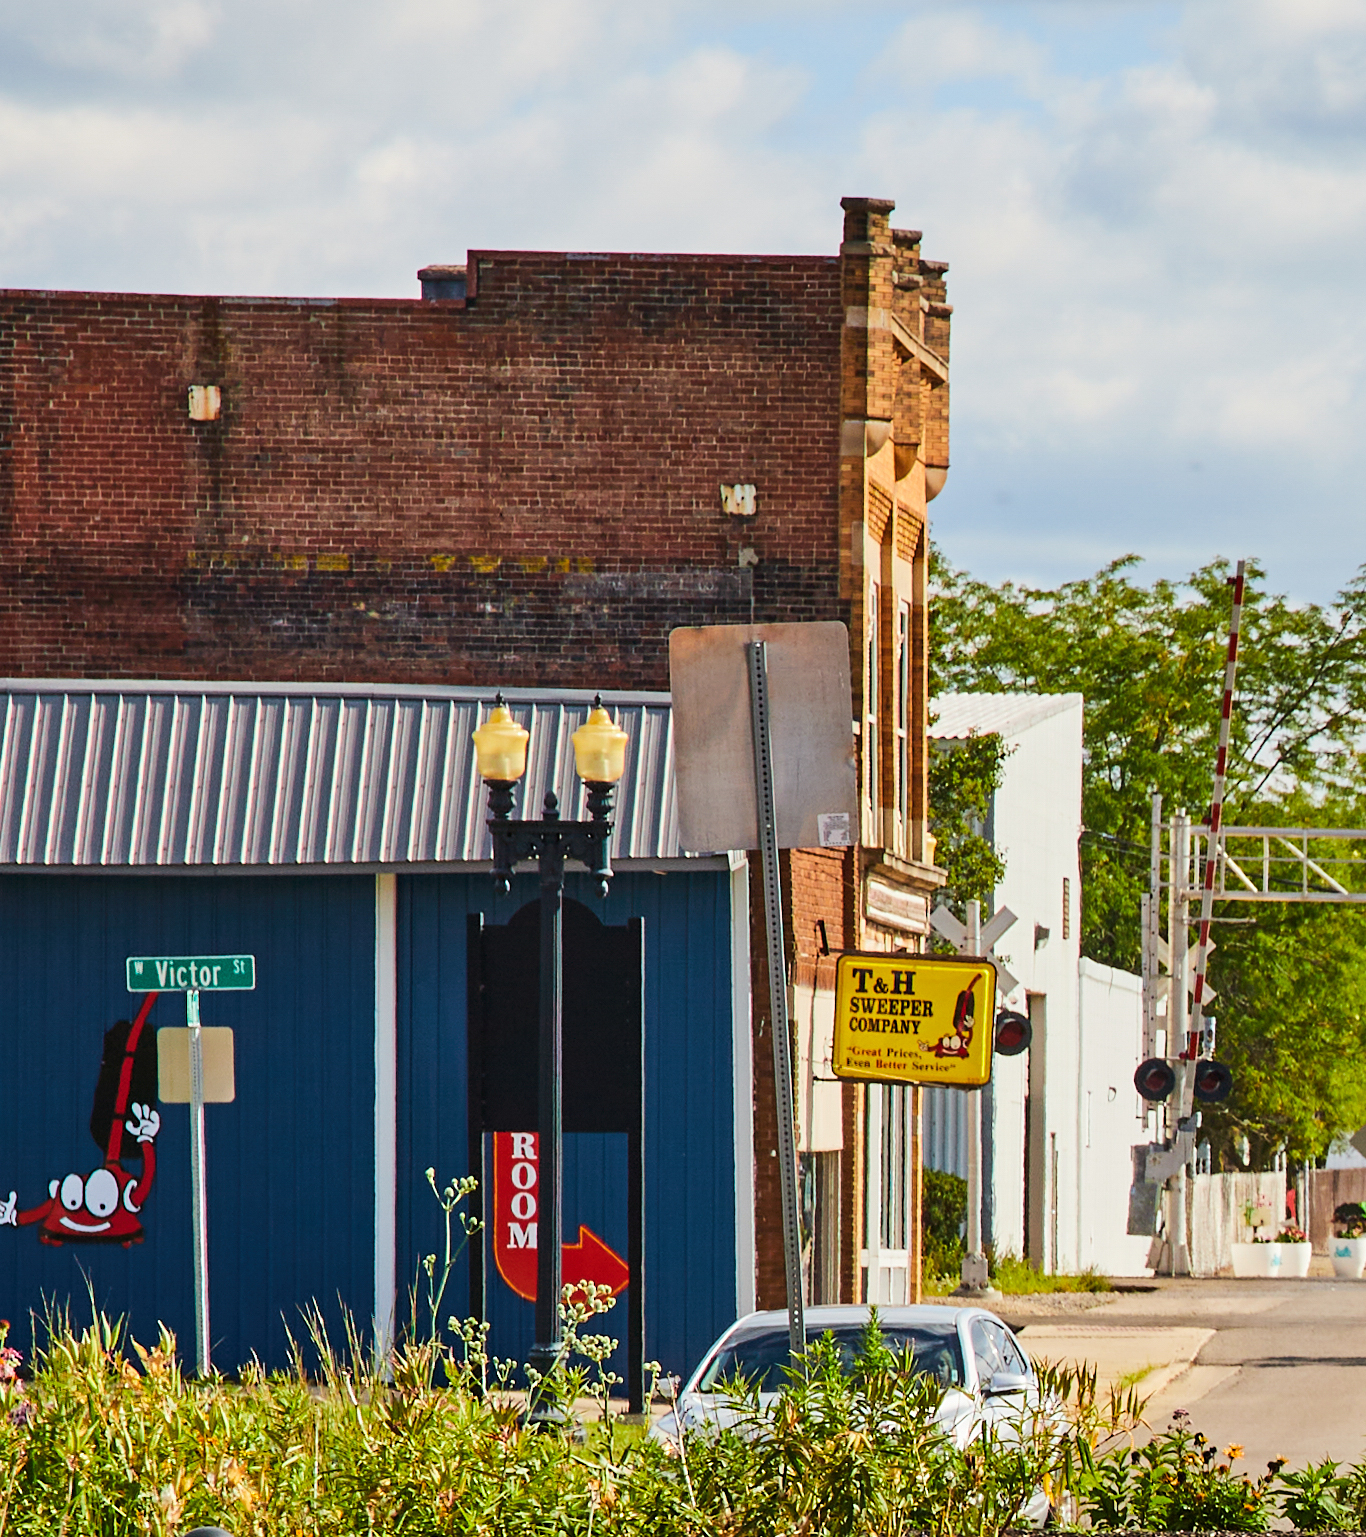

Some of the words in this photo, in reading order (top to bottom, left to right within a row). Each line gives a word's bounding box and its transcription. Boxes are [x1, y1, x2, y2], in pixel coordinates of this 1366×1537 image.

[134, 961, 144, 975] W
[155, 960, 221, 987] Victor
[233, 958, 246, 974] St
[850, 997, 934, 1017] SWEEPER
[849, 1017, 922, 1035] COMPANY
[846, 1057, 871, 1068] Even
[876, 1059, 907, 1070] Better
[887, 1048, 922, 1060] Prices,
[507, 1132, 538, 1249] ROOM
